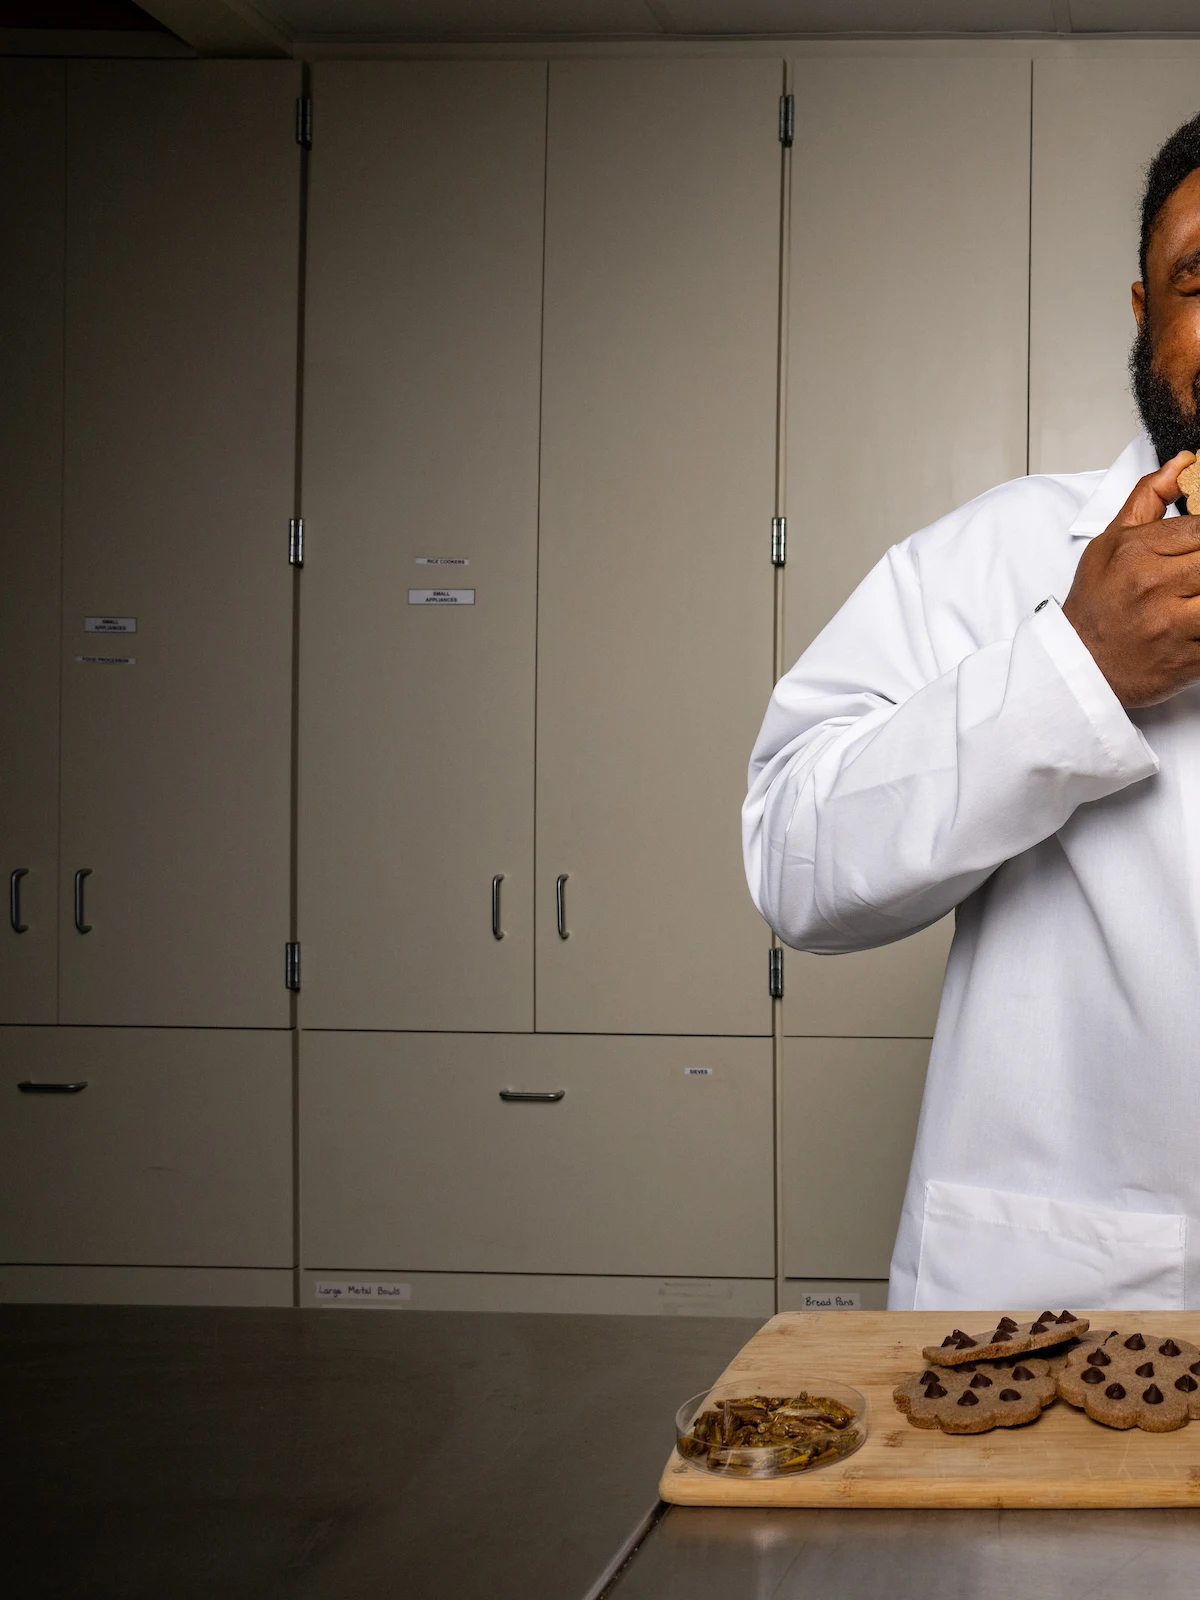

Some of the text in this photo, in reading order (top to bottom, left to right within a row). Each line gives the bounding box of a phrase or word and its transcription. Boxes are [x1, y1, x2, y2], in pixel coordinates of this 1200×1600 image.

[318, 1285, 401, 1298] Large Metal Bowls
[805, 1296, 854, 1307] Bread Pans
